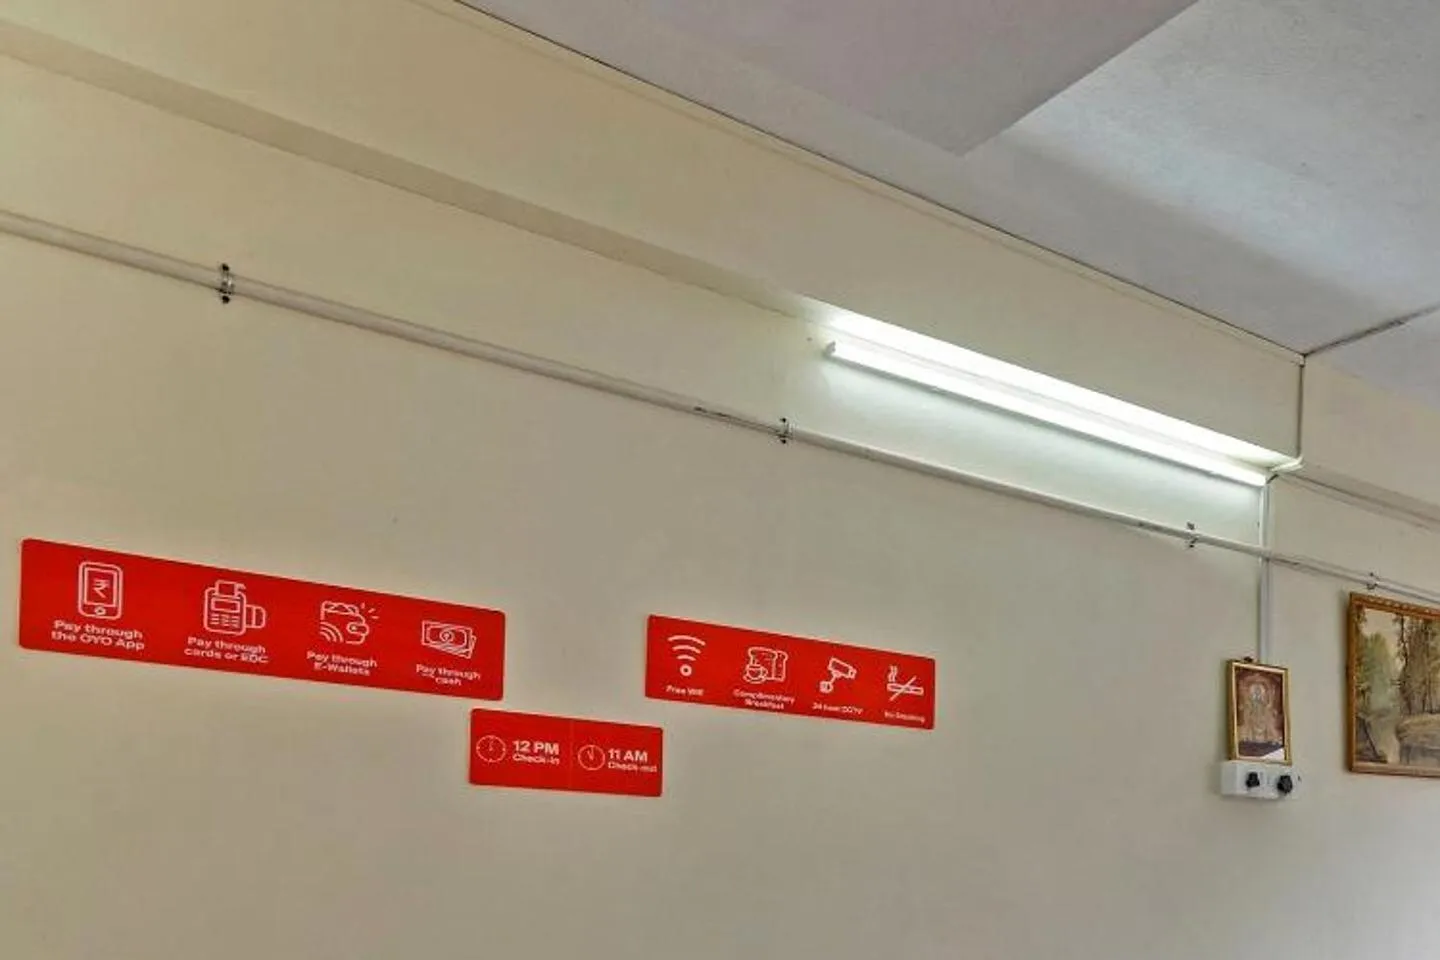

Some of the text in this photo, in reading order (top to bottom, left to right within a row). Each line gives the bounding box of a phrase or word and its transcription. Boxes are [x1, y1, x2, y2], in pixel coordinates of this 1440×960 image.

[54, 619, 144, 640] Pay through
[51, 630, 145, 652] the OYO App
[187, 635, 266, 654] Pay through
[184, 647, 222, 659] cards
[223, 651, 240, 661] or
[306, 650, 378, 668] Pay through
[313, 661, 371, 677] E-Wallets
[415, 663, 481, 681] Pay through
[435, 677, 462, 687] cash
[744, 698, 785, 710] Breakfast
[512, 739, 560, 756] 12 PM
[607, 748, 648, 763] 11 AM
[512, 752, 560, 765] Check-in
